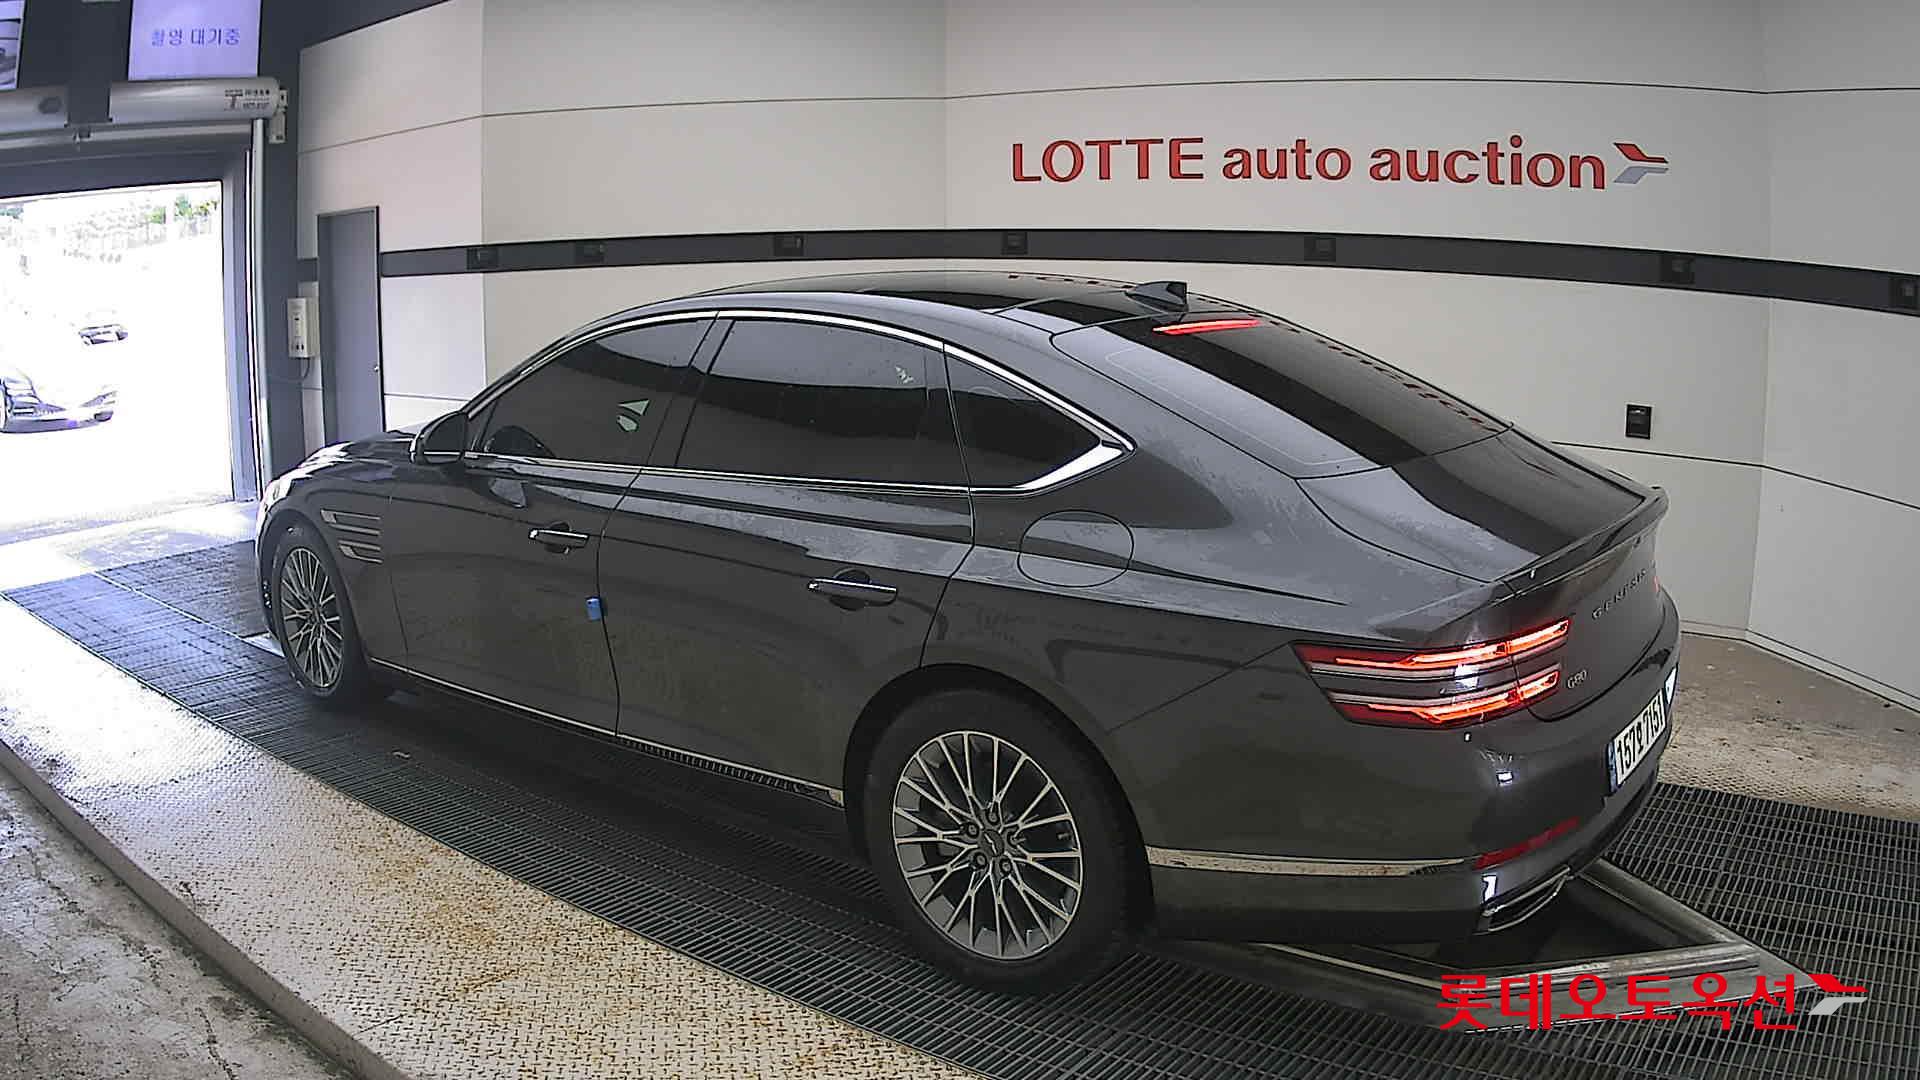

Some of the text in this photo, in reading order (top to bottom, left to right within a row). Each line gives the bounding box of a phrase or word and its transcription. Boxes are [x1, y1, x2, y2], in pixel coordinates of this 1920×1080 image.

[191, 28, 240, 45] 대기중
[1012, 135, 1606, 190] LOTTE auto auction
[1566, 669, 1587, 689] G80
